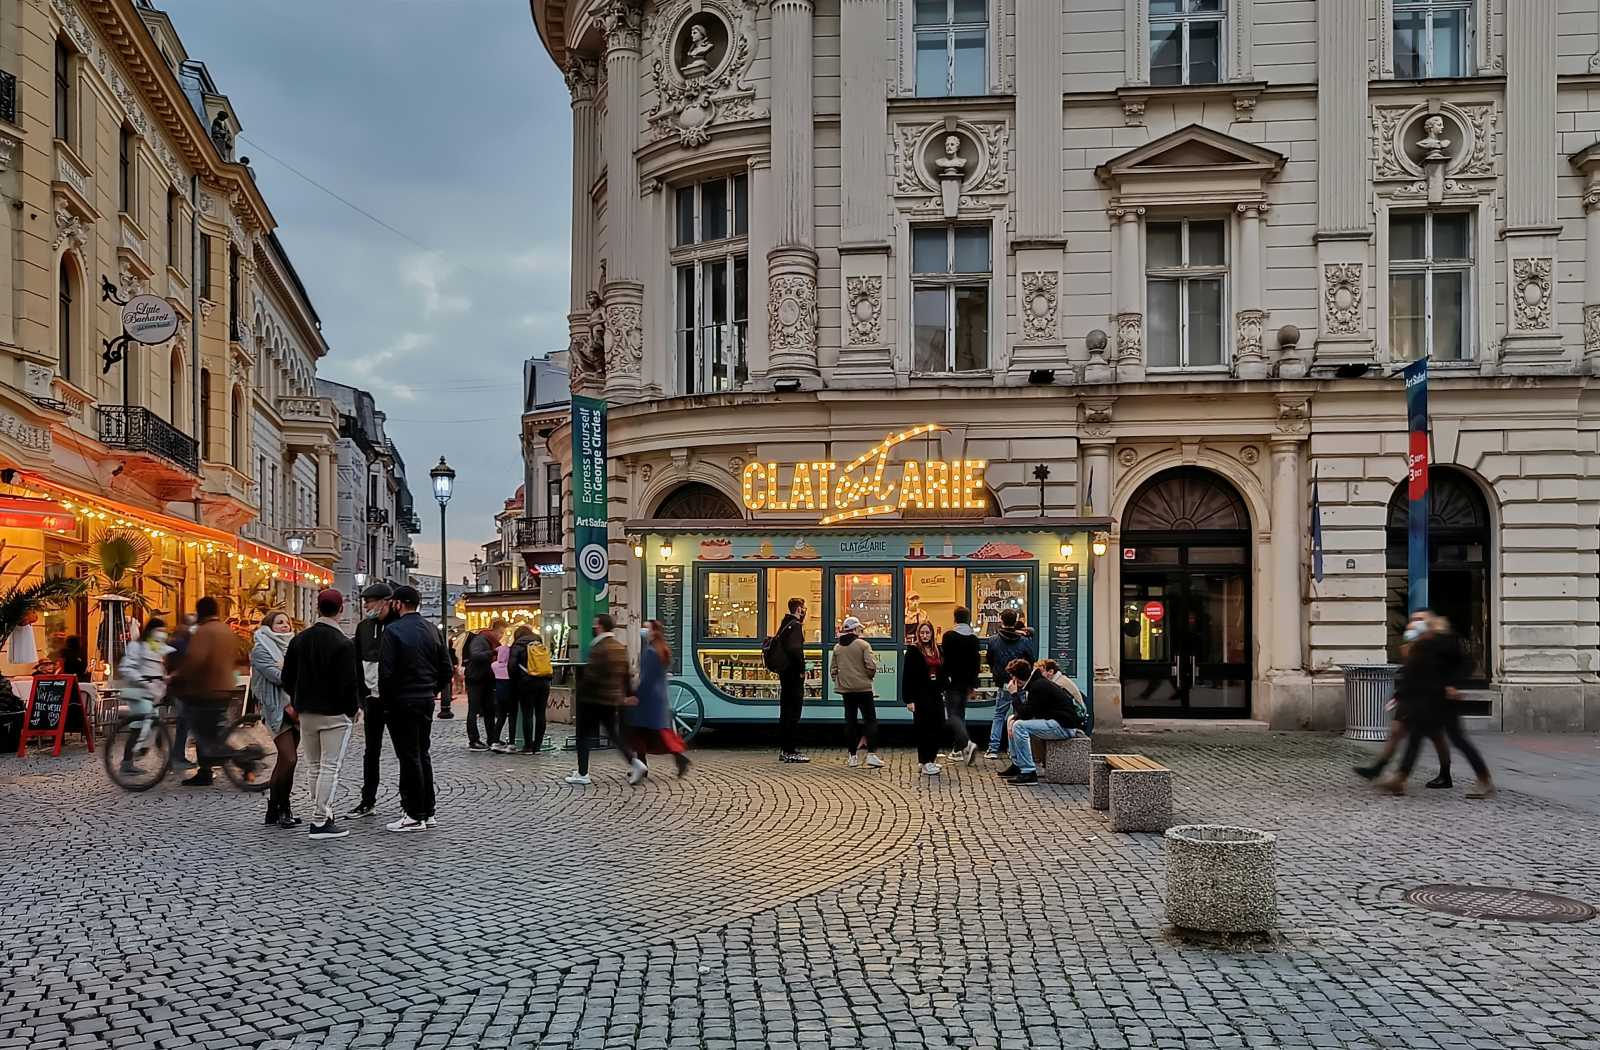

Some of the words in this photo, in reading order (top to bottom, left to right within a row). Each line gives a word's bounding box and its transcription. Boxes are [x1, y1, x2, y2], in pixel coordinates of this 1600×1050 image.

[579, 407, 593, 455] yourself
[591, 409, 602, 448] Circles
[582, 457, 593, 504] Express
[593, 449, 604, 491] George
[898, 459, 986, 509] ARIE
[576, 516, 589, 527] Art
[870, 541, 887, 551] ARIE
[977, 588, 1002, 599] Collect
